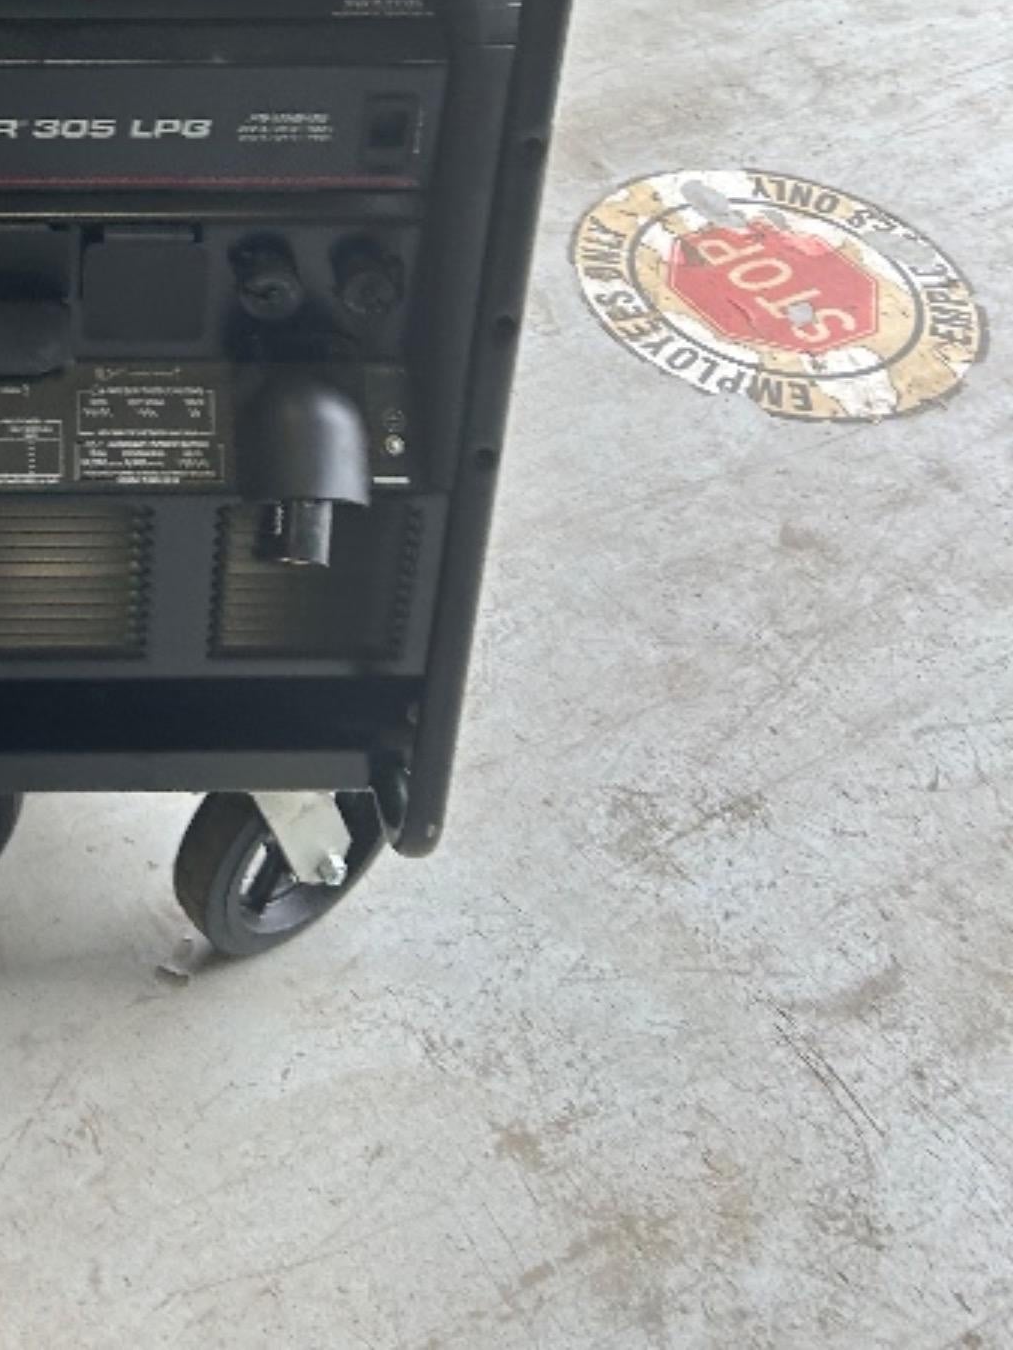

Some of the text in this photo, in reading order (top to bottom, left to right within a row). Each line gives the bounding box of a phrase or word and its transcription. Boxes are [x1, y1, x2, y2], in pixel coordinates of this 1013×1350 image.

[32, 118, 116, 140] 305
[130, 118, 213, 140] LPG
[696, 238, 856, 343] STOP
[596, 290, 813, 412] EMPLOYEES
